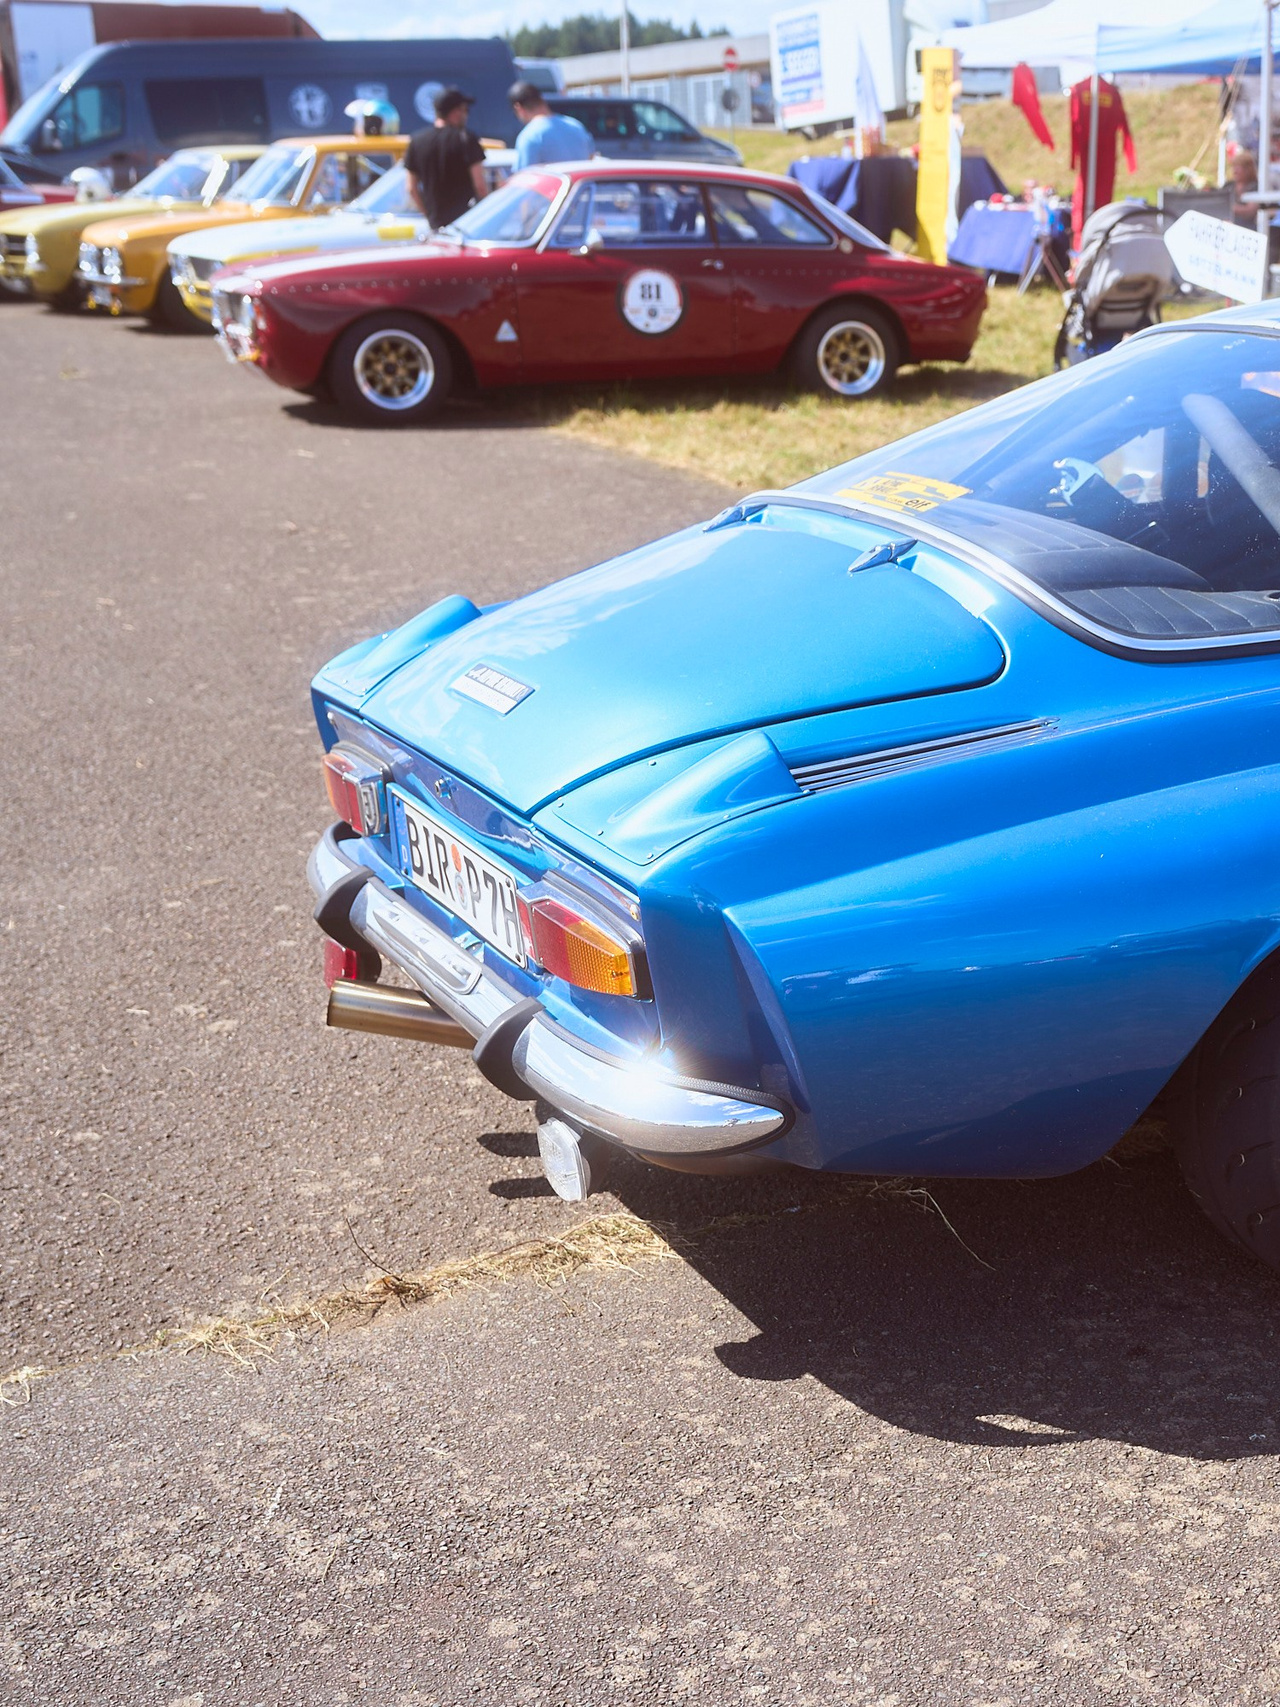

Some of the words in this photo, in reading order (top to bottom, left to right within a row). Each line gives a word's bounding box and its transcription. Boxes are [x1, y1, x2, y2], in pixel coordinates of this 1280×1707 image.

[641, 283, 661, 300] 81
[904, 498, 932, 510] elf
[406, 814, 456, 902] BIR
